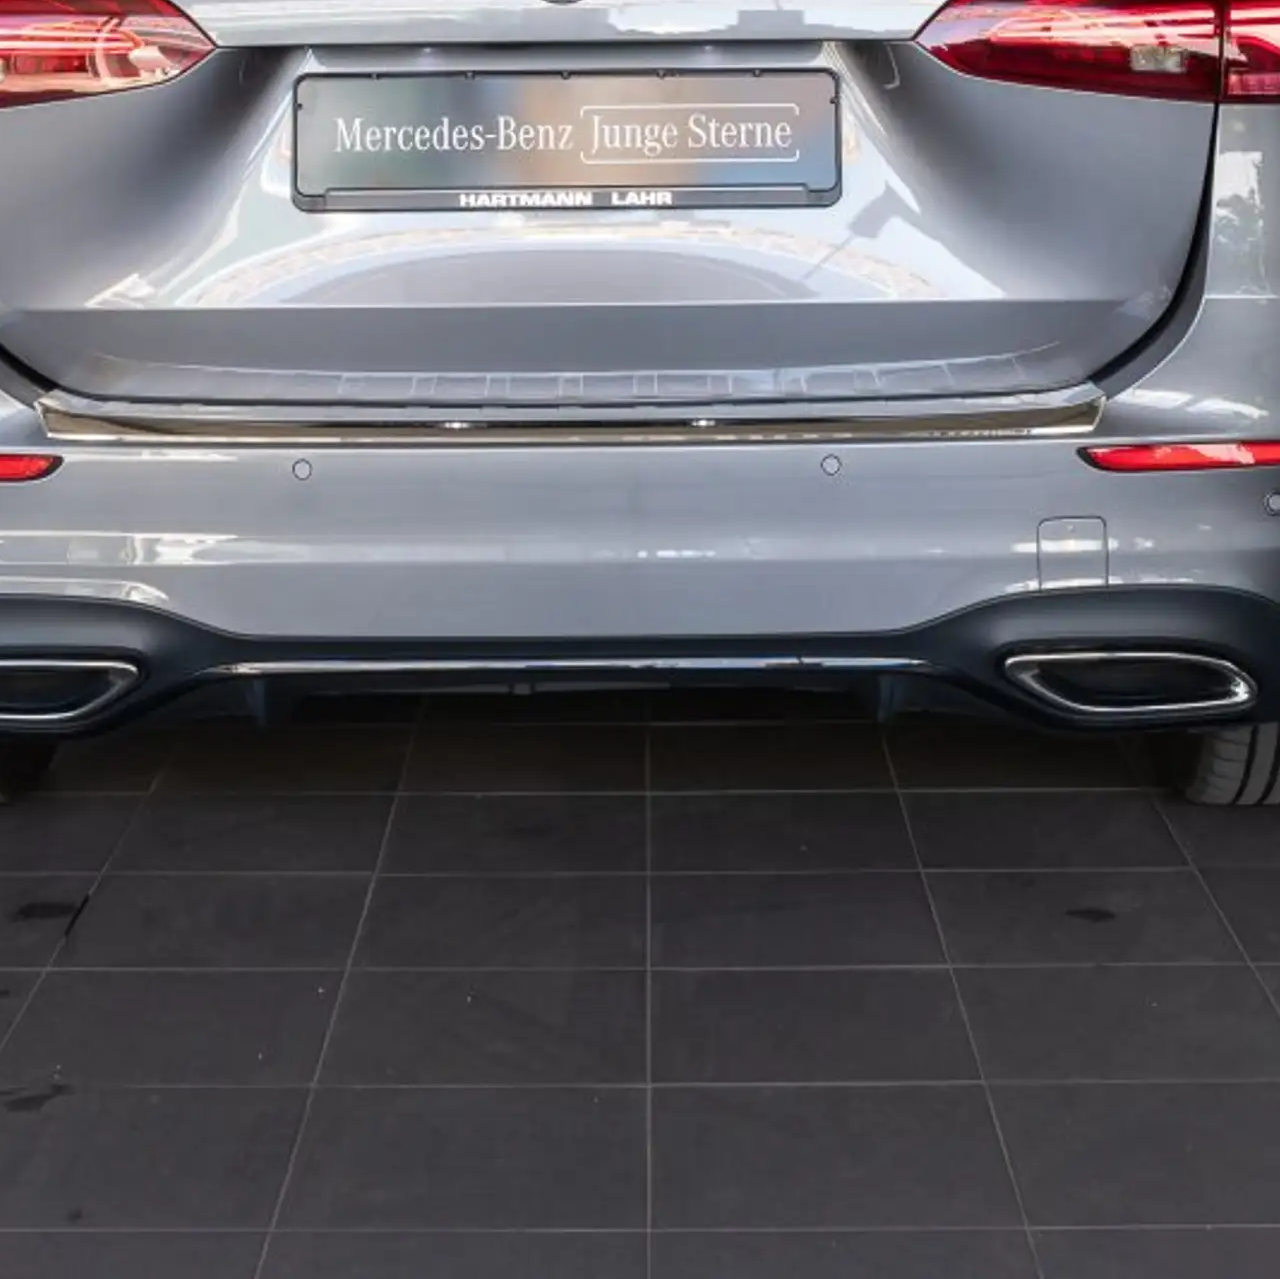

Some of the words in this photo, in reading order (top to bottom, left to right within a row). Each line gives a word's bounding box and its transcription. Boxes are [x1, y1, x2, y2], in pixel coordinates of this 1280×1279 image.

[333, 116, 573, 153] Mercedes-Benz
[590, 114, 679, 156] Junge
[687, 113, 793, 149] Sterne
[459, 191, 593, 207] HARTMANN
[611, 191, 673, 206] LAHR
